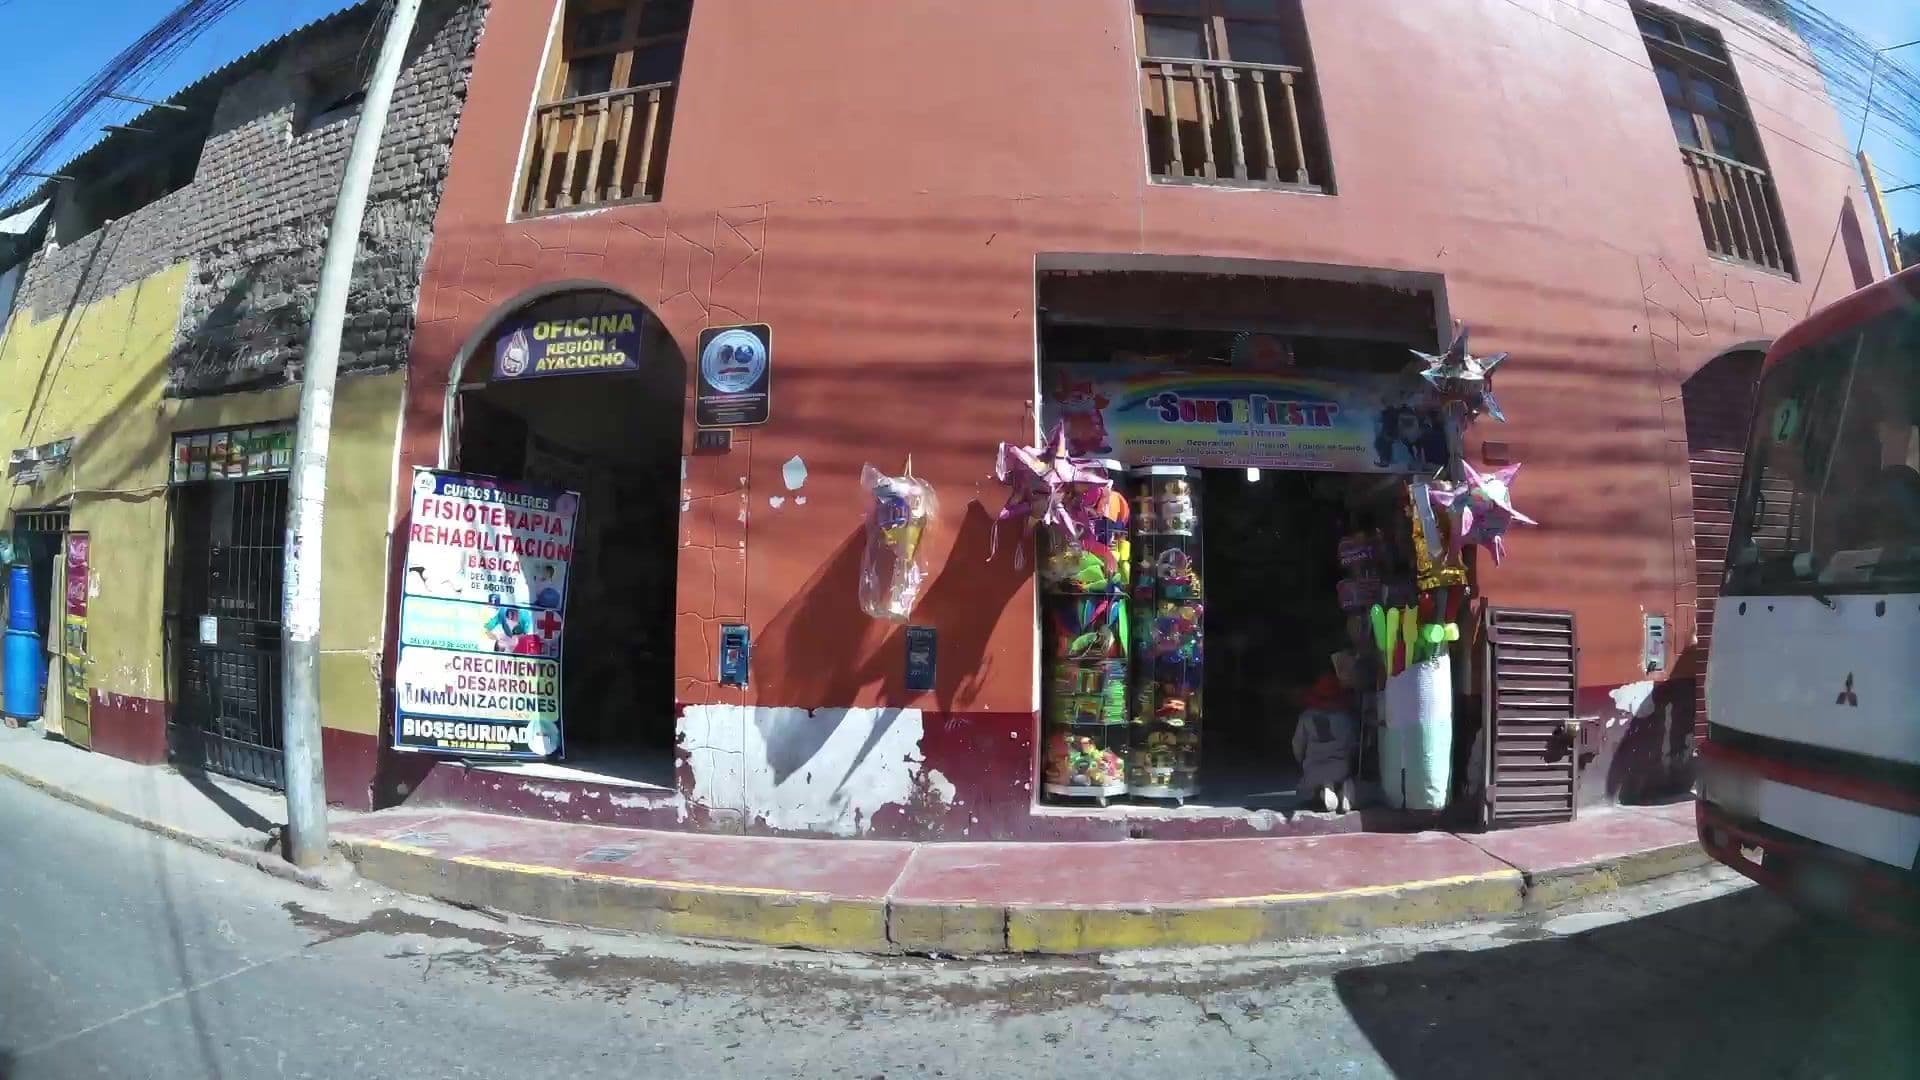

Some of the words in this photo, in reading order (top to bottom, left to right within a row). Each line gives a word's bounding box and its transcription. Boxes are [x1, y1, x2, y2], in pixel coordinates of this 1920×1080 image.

[533, 313, 635, 341] OFICINA
[546, 338, 604, 356] REGIÓN
[535, 352, 626, 372] AYACUCHO
[1778, 408, 1791, 441] 2
[443, 483, 490, 501] CURSOS
[493, 490, 549, 509] TALLERES
[471, 582, 481, 590] DE
[483, 583, 515, 594] AGOSTO
[452, 655, 556, 679] CRECIMIENTO
[457, 674, 555, 697] DESARROLLO
[415, 687, 557, 713] INMUNIZACIONES
[402, 718, 529, 744] BIOSEGURIDAD
